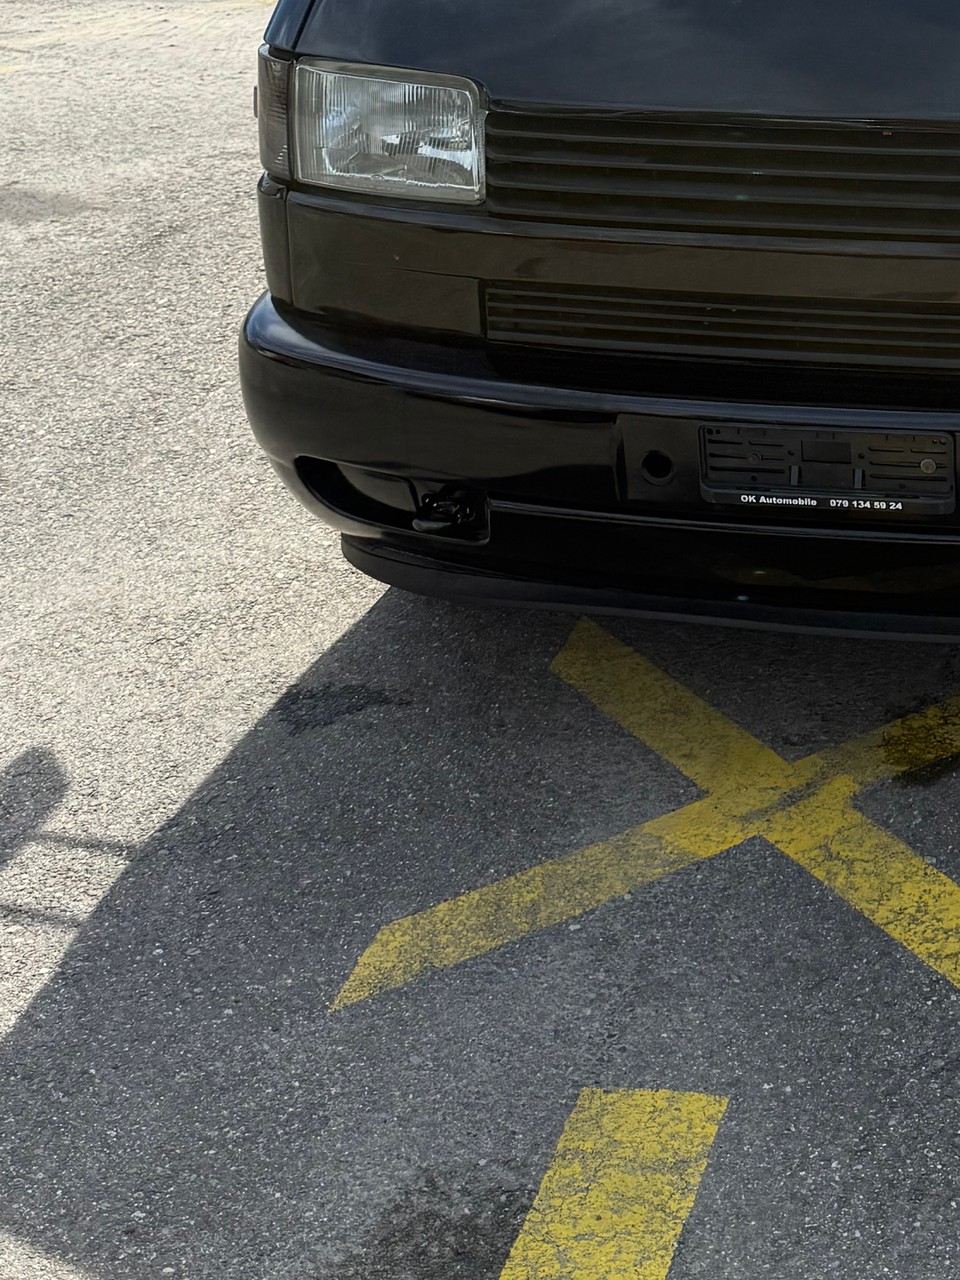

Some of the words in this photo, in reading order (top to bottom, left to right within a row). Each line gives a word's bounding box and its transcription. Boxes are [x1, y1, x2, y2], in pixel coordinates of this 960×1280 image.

[740, 494, 757, 503] OK
[759, 495, 817, 506] Automobile
[829, 499, 849, 508] 079
[852, 500, 871, 509] 134
[873, 501, 887, 509] 59
[889, 502, 903, 510] 24
